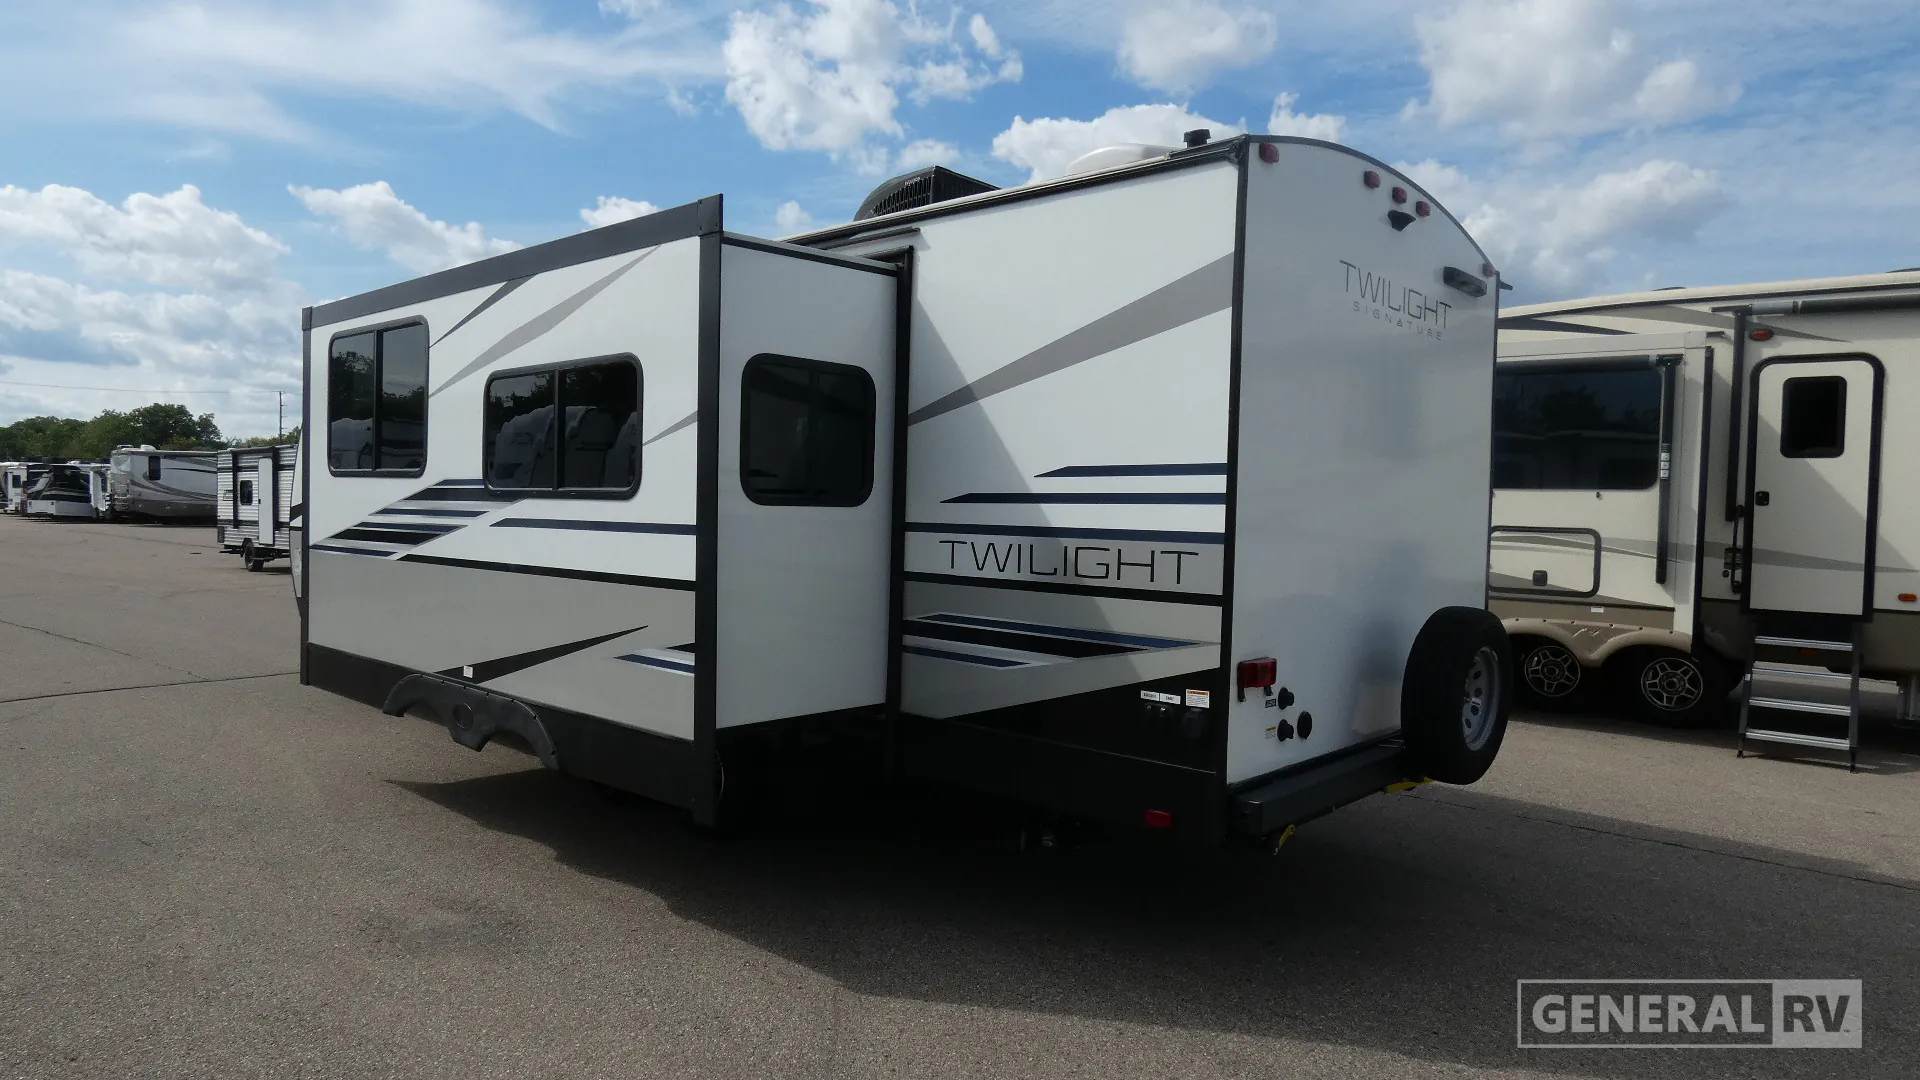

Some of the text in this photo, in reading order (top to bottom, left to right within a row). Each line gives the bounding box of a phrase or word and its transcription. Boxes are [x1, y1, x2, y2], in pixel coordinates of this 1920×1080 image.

[1339, 259, 1452, 329] TWILIGHT
[1352, 301, 1443, 341] SIGNATURE
[939, 540, 1199, 585] TWILIGHT
